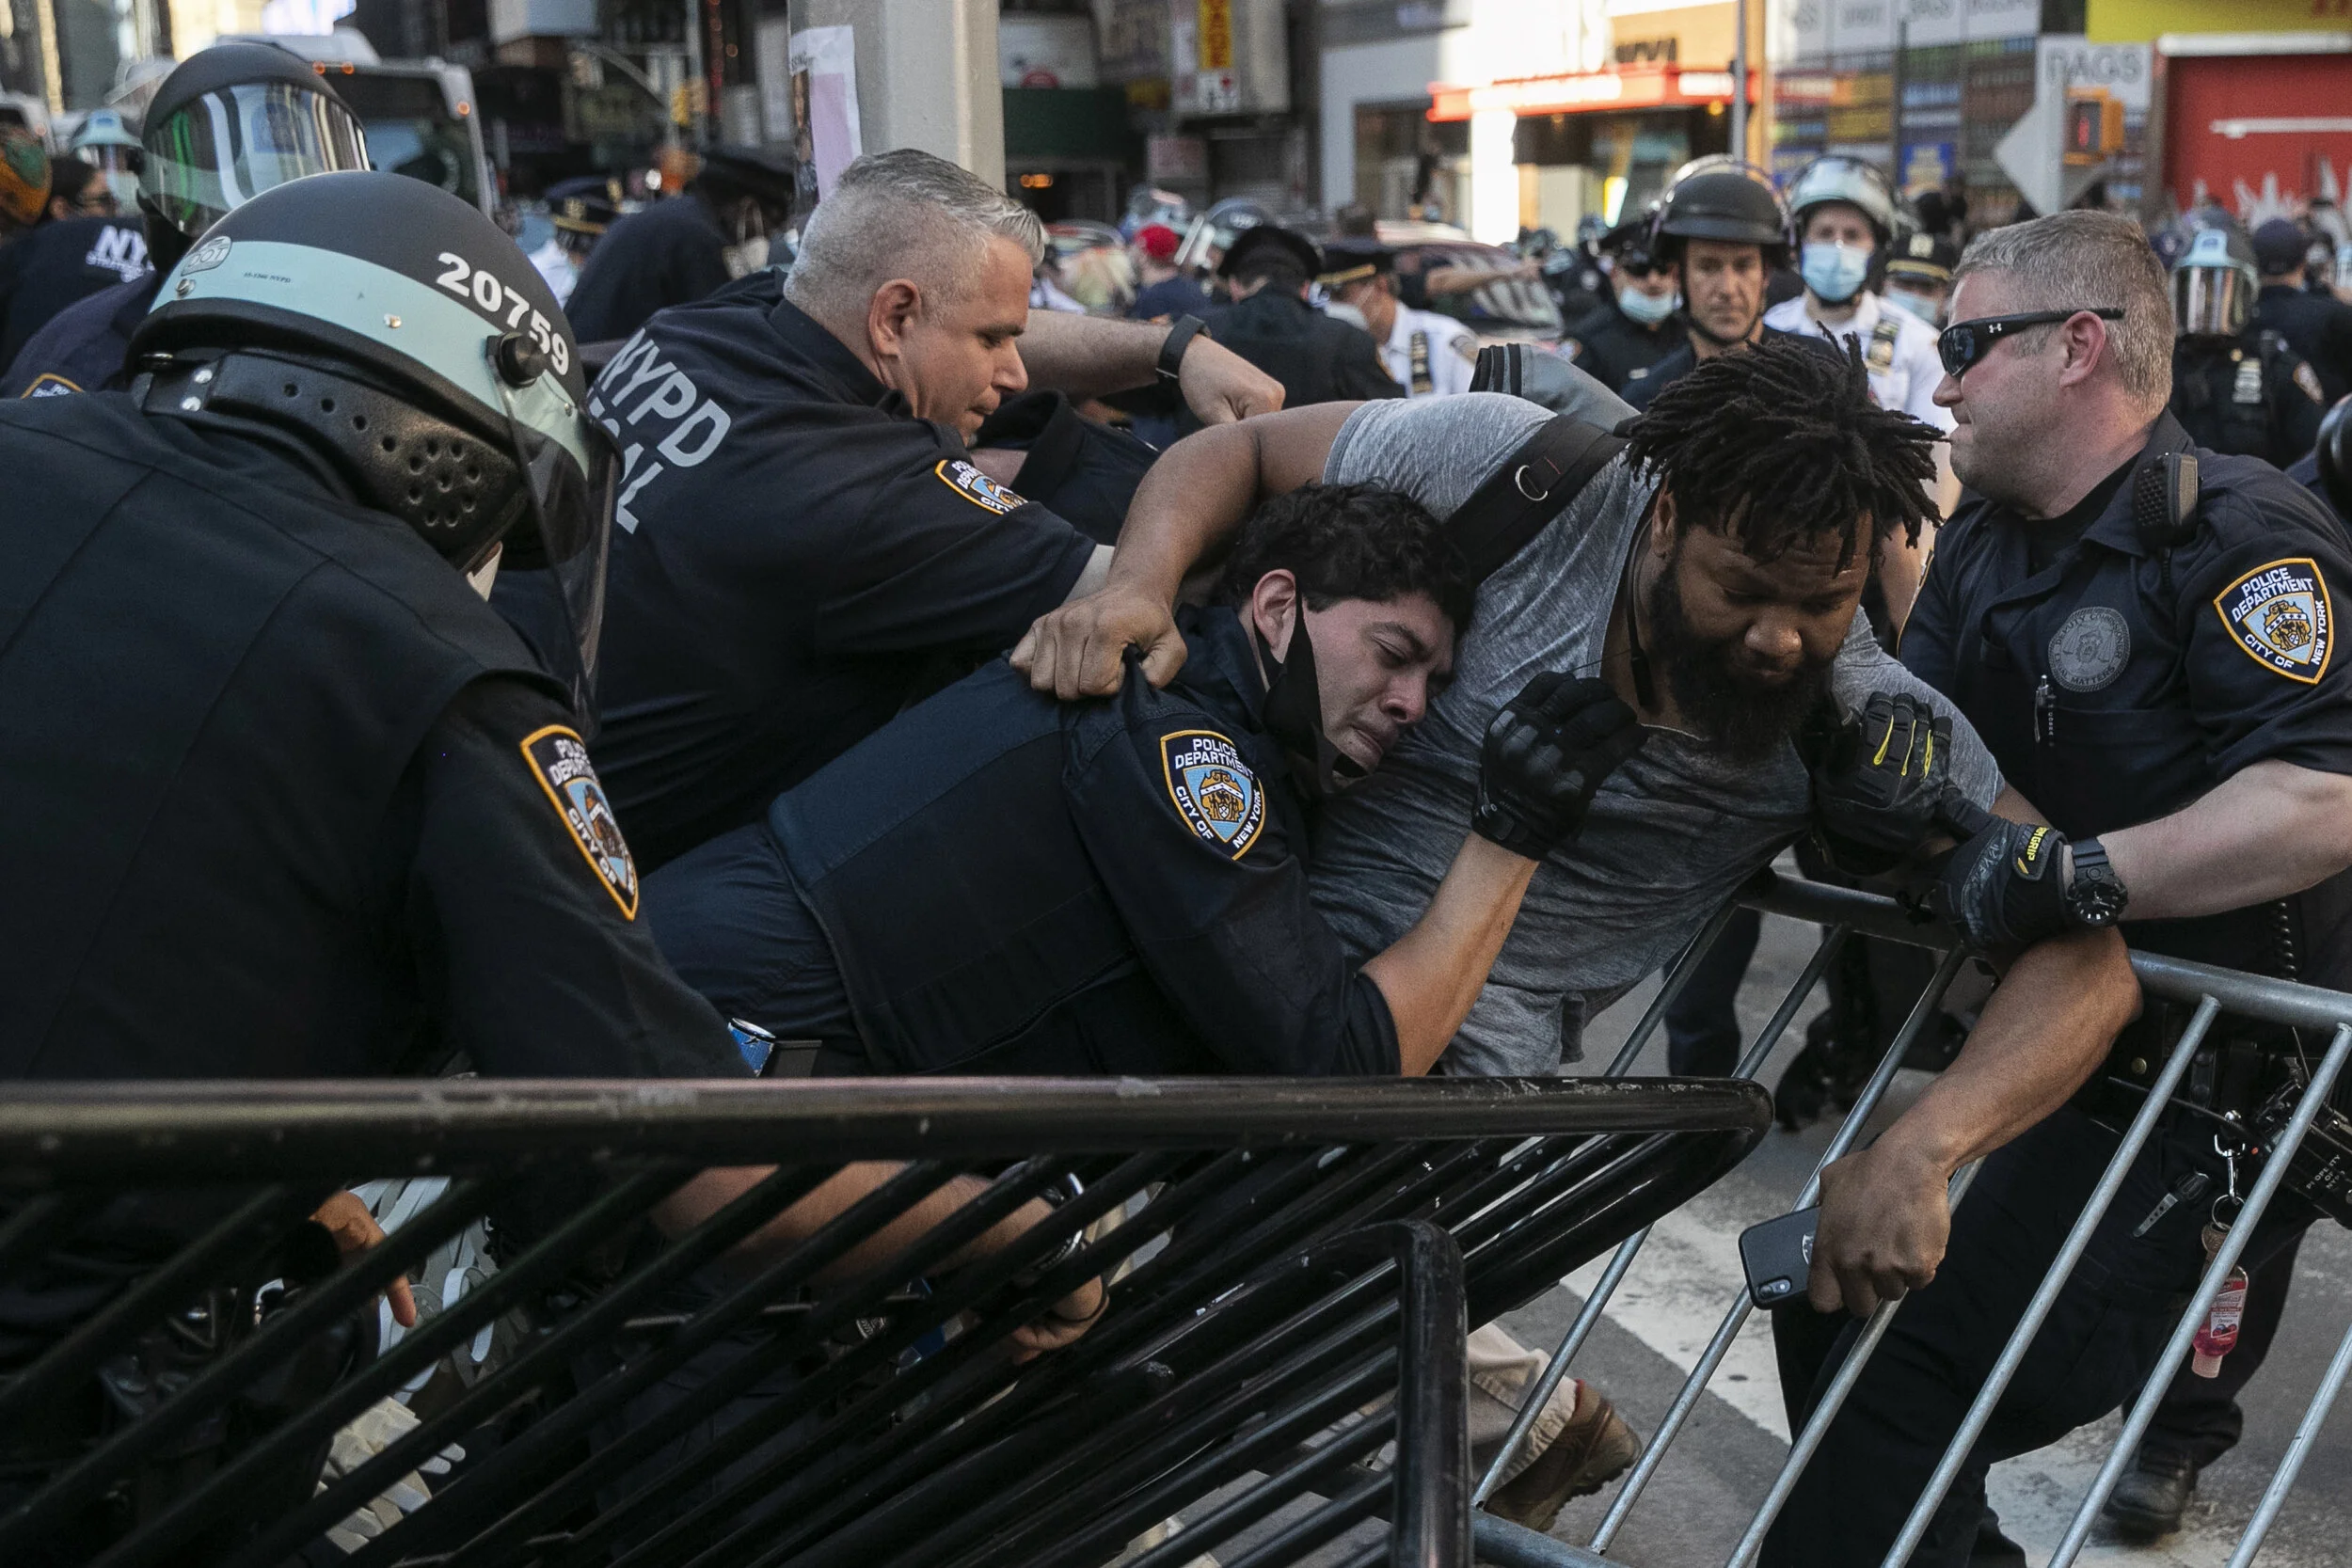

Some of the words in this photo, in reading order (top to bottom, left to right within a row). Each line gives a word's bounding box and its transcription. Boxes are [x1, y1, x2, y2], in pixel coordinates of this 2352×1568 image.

[187, 246, 229, 267] DOT
[437, 252, 569, 375] 20759
[596, 327, 731, 467] NYPD
[2241, 567, 2291, 596] POLICE
[2232, 578, 2313, 623] DEPARTMENT
[2315, 600, 2327, 634] YORK
[2245, 634, 2273, 657] CITY
[2274, 656, 2295, 669] OF
[2311, 638, 2326, 665] NEW
[1192, 738, 1238, 759] POLICE
[1175, 752, 1254, 781] DEPARTMENT
[1176, 786, 1200, 817] CITY
[1197, 820, 1214, 839] OF
[1232, 822, 1255, 848] NEW
[1250, 789, 1261, 822] YORK
[568, 808, 599, 853] CITY
[599, 857, 617, 884] OF
[2026, 836, 2042, 861] GRIP
[2306, 1154, 2340, 1189] POPETY
